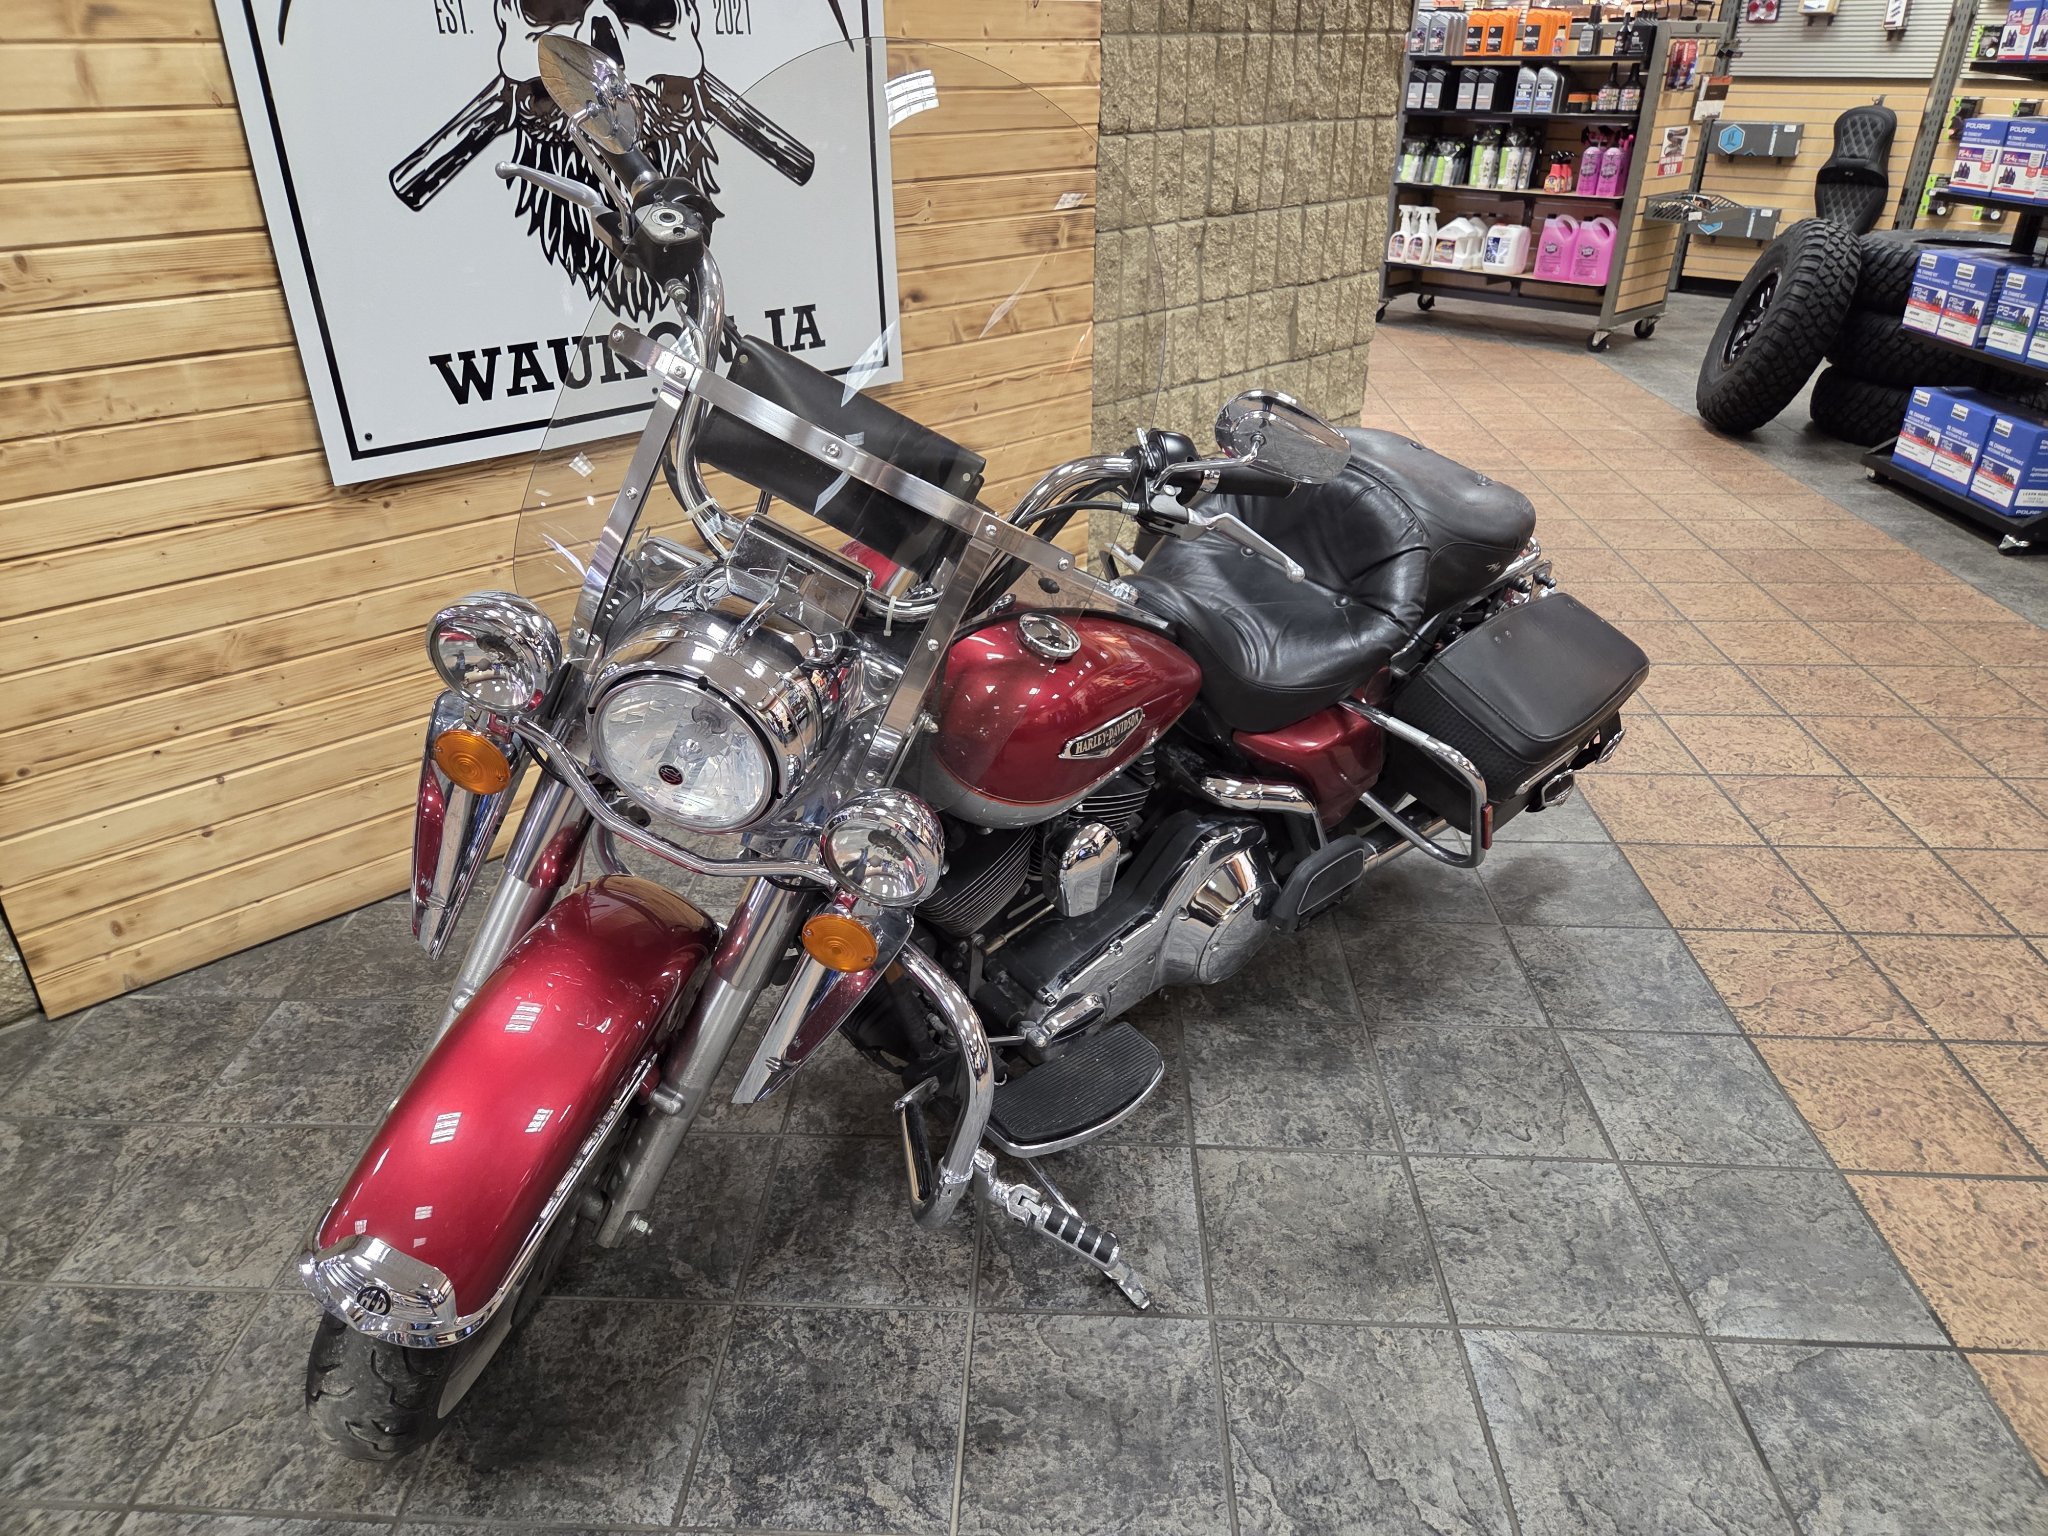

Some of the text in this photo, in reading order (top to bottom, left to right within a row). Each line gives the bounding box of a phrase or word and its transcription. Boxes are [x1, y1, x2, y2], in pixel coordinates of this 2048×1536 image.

[434, 0, 752, 36] EST. 2021
[1965, 122, 1991, 130] POLARIS
[2009, 125, 2036, 134] POLARIS
[765, 303, 826, 352] IA
[1075, 712, 1139, 755] HARLEY-DAVIDSON
